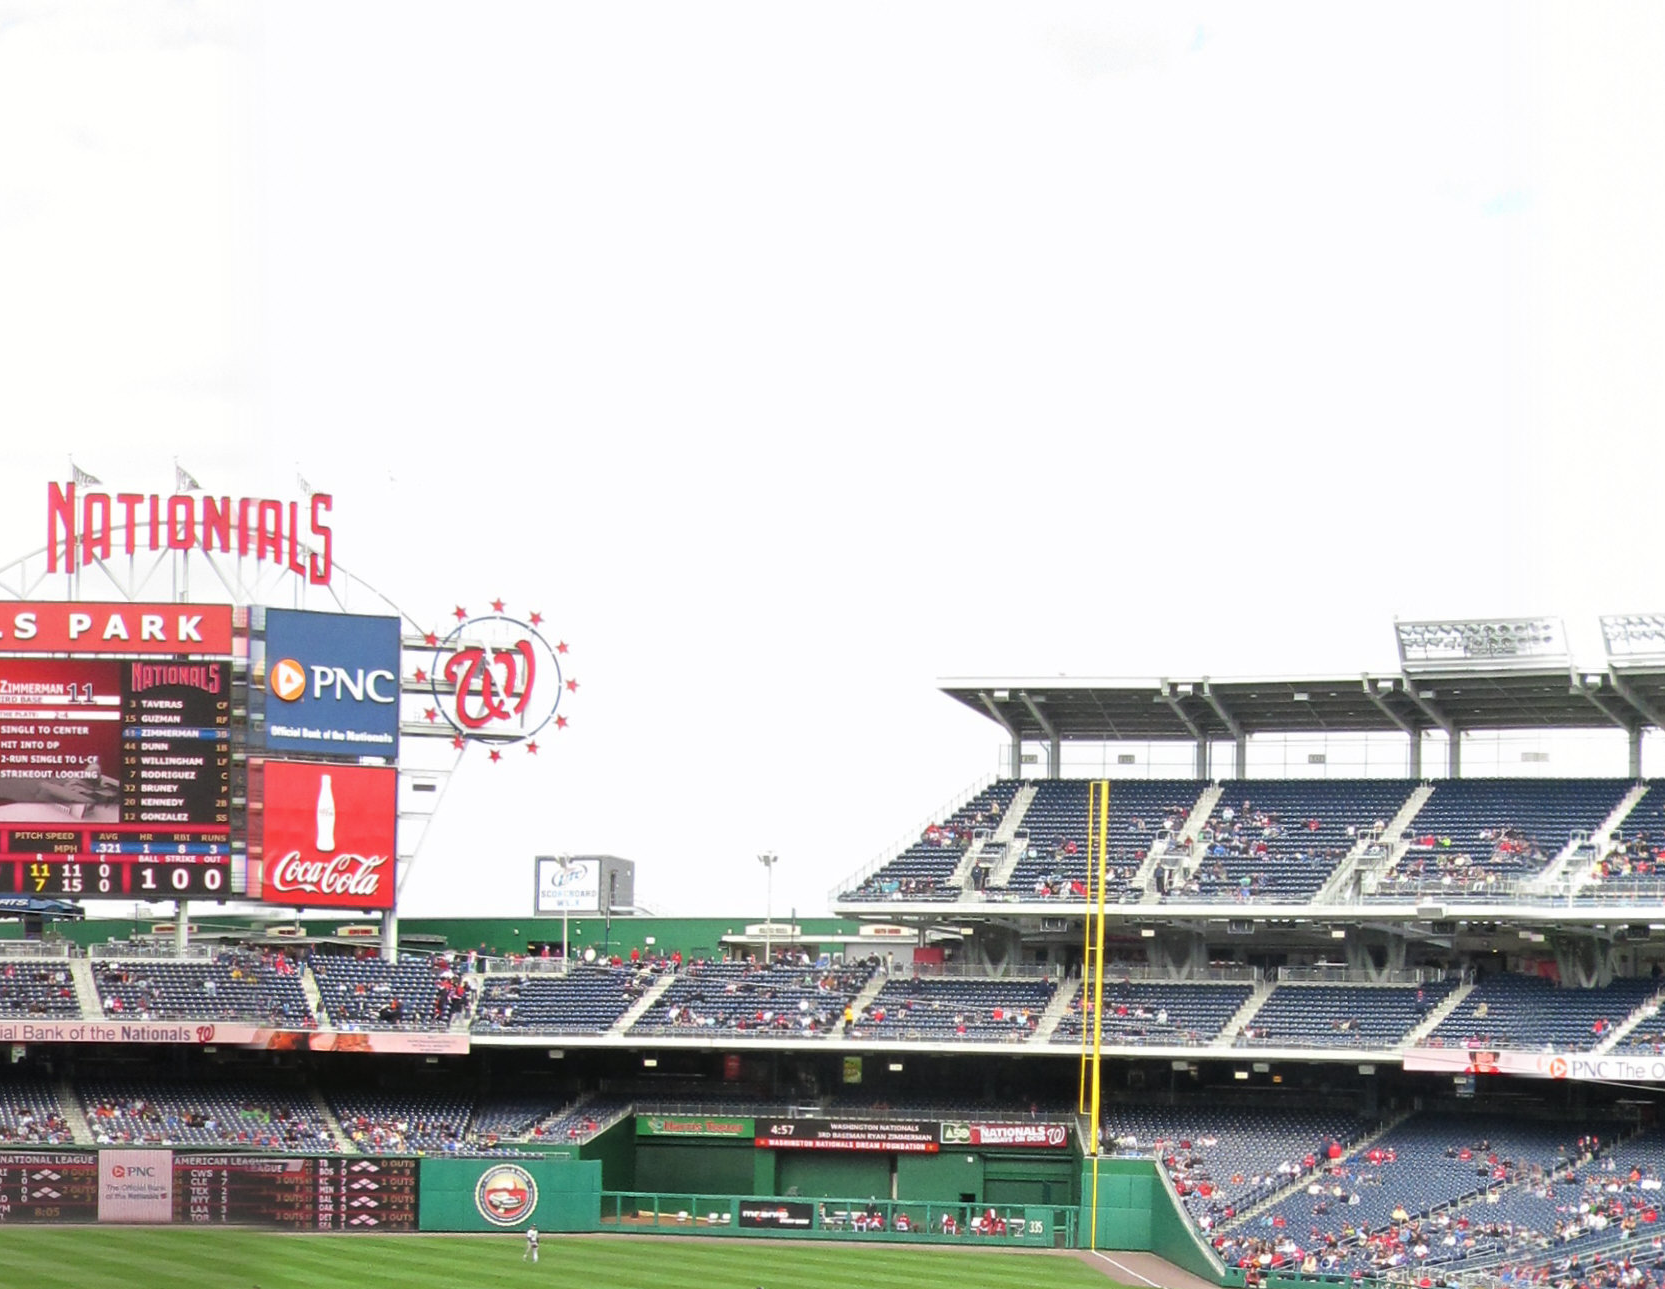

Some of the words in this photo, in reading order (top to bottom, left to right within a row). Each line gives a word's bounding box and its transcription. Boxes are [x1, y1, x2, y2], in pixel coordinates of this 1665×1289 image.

[68, 613, 205, 642] PARK
[131, 662, 220, 694] NATIONALS
[311, 664, 395, 703] PNC
[0, 681, 64, 695] ZIMMERMAN
[67, 683, 97, 704] 11
[141, 701, 183, 709] TAVERAS
[141, 715, 180, 724] GUZMAN
[1, 726, 35, 734] SINGLE
[38, 726, 51, 734] TO
[54, 726, 88, 735] CENTER
[141, 730, 199, 738] ZIMMERMAN
[141, 743, 168, 751] DUNN
[141, 757, 203, 766] WILLINGHAM
[1, 770, 53, 779] STRIKEOUT
[56, 770, 98, 779] LOOKING
[141, 771, 196, 780] RODRIGUEZ
[141, 785, 178, 793] BRUNEY
[141, 799, 184, 807] KENNEDY
[141, 813, 188, 821] GONZALEZ
[15, 832, 43, 840] PITCH
[46, 832, 75, 840] SPEED
[99, 833, 118, 841] AVG
[201, 834, 226, 842] RUNS
[54, 845, 78, 853] MPH
[138, 855, 159, 863] BALL
[165, 855, 196, 863] STRIKE
[204, 855, 221, 863] OUT
[30, 865, 50, 877] 11
[62, 865, 81, 877] 11
[273, 851, 389, 896] Coca-Cola
[141, 869, 156, 889] 1
[172, 868, 189, 890] 0
[204, 868, 221, 890] 0
[61, 879, 82, 892] 15
[23, 1024, 63, 1040] Bank
[69, 1025, 86, 1040] of
[89, 1025, 115, 1040] the
[121, 1025, 190, 1041] Nationals
[1572, 1062, 1608, 1079] PNC
[1617, 1063, 1645, 1079] The
[771, 1125, 794, 1135] 4:57
[980, 1126, 1045, 1137] NATIONALS
[0, 1155, 52, 1164] NATIONAL
[55, 1155, 94, 1165] LEAGUE
[175, 1157, 228, 1165] AMERICAN
[128, 1167, 154, 1177] PNC
